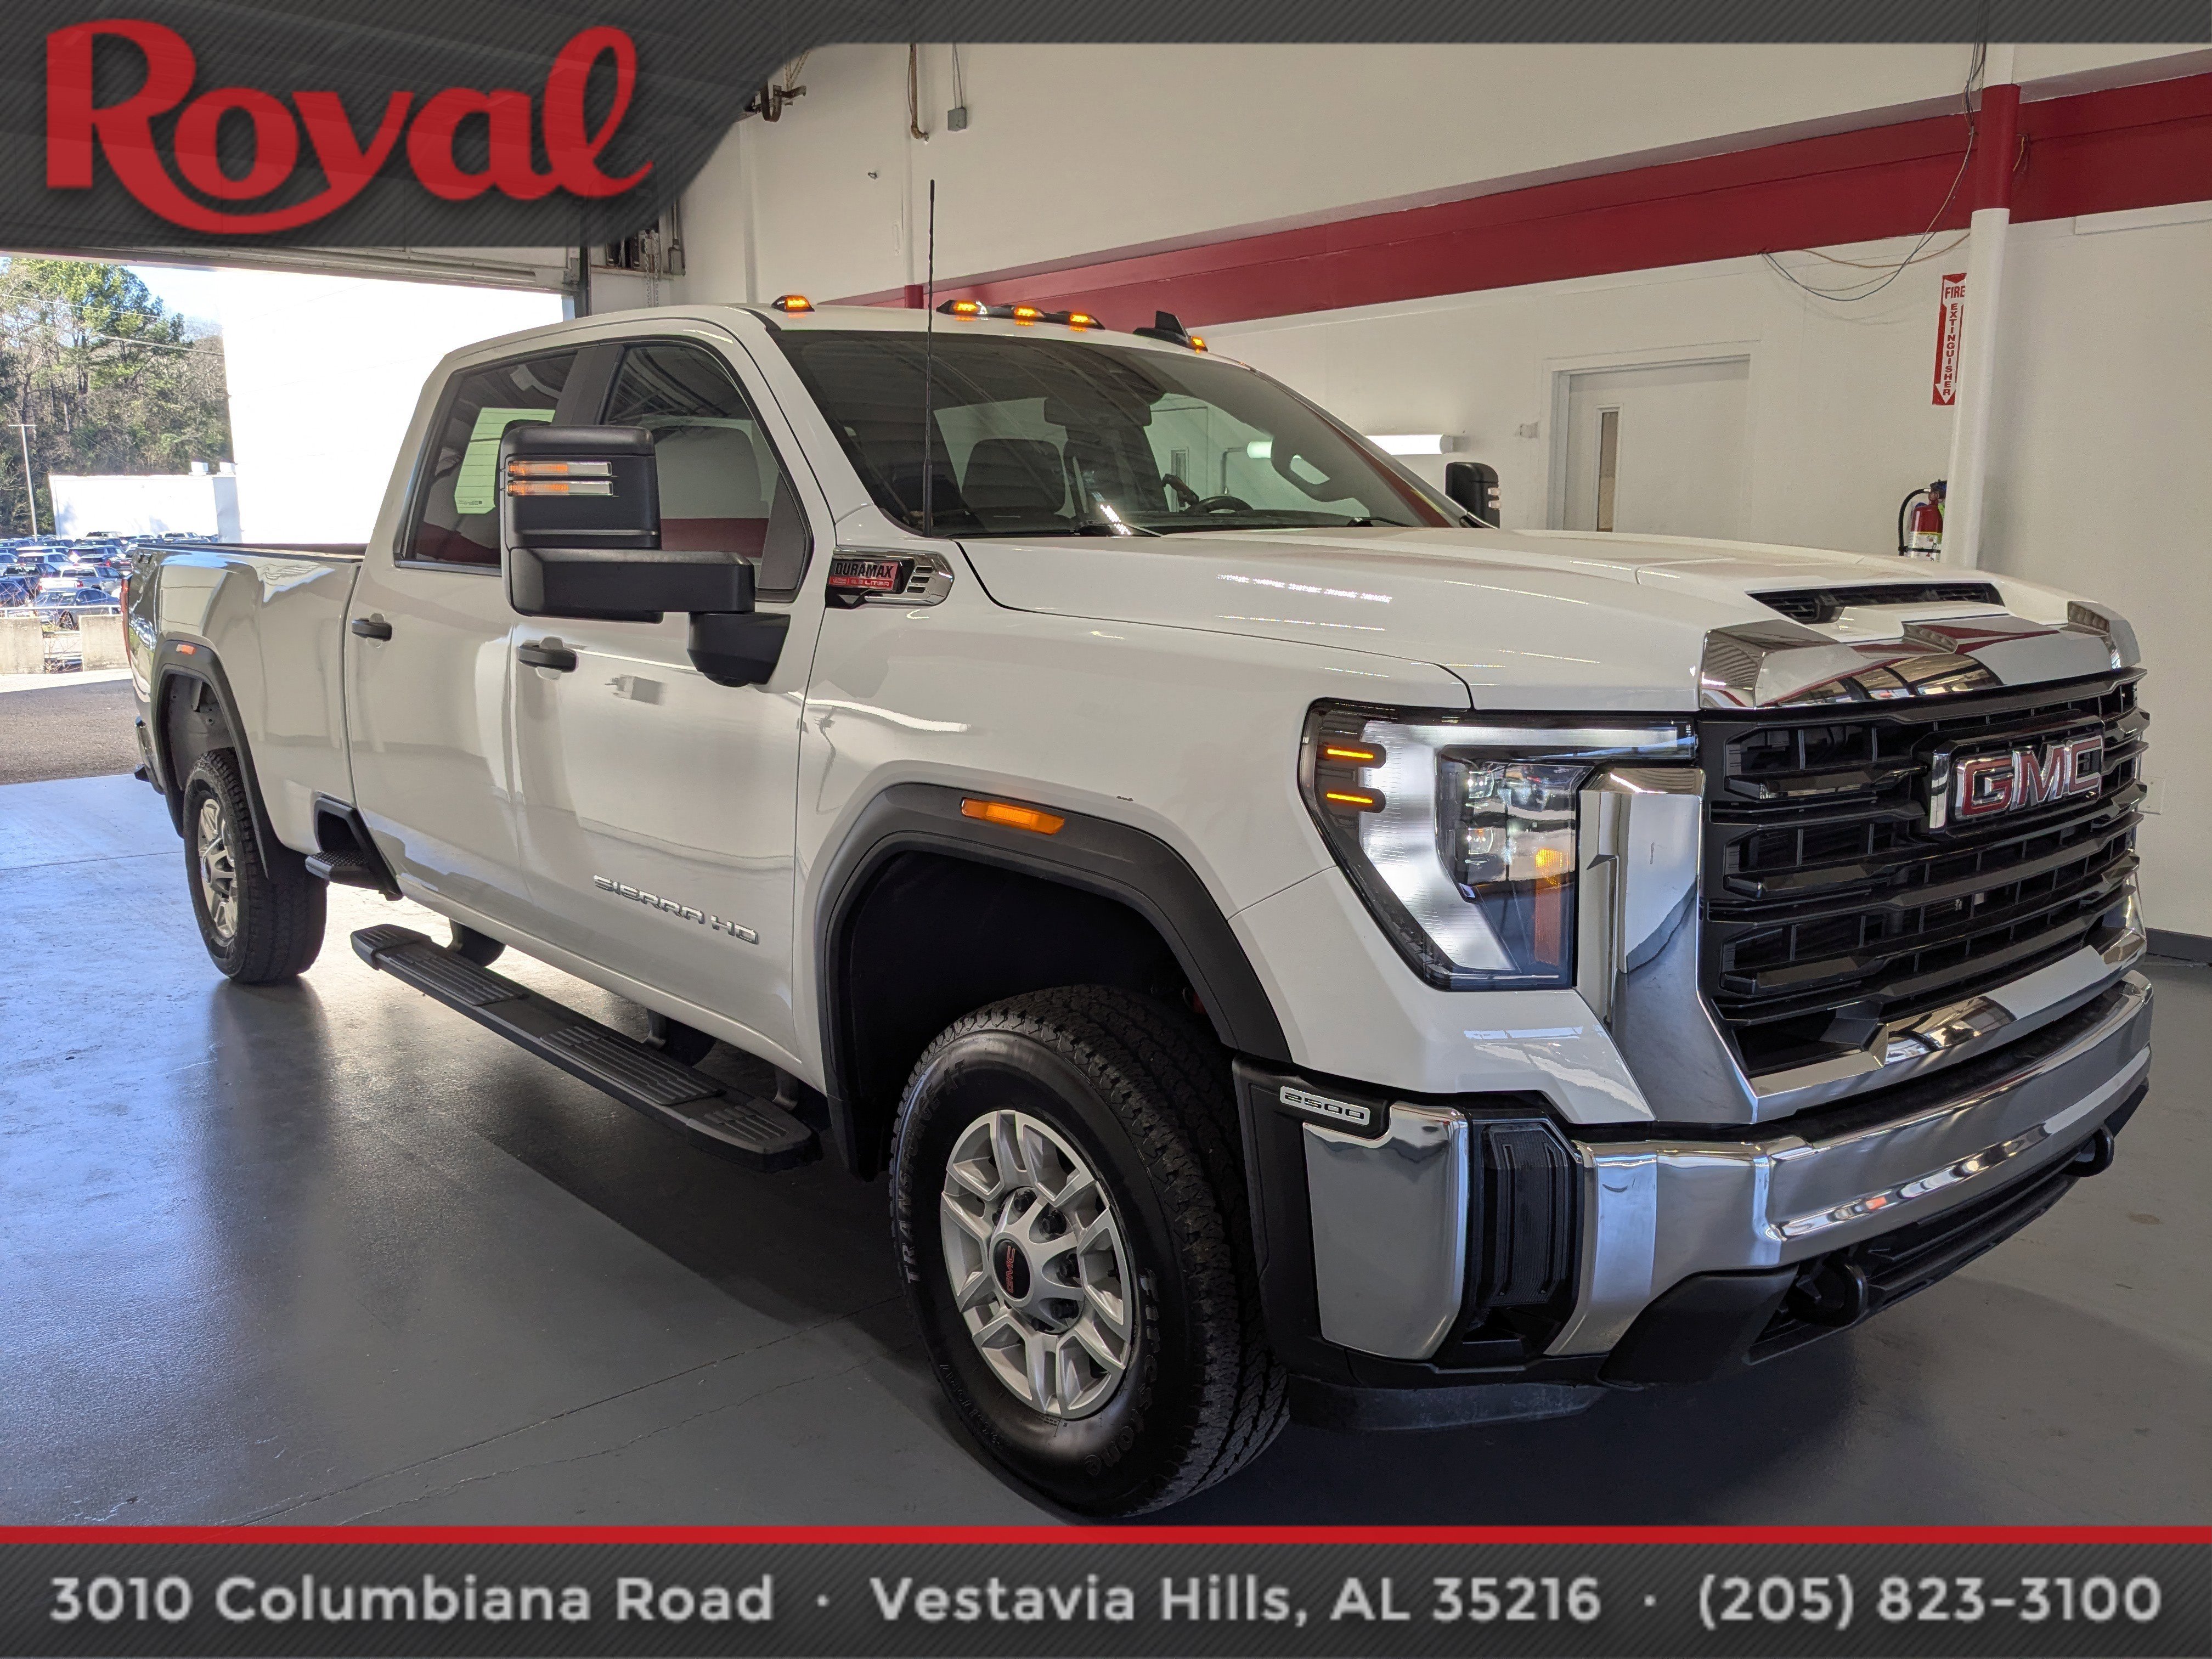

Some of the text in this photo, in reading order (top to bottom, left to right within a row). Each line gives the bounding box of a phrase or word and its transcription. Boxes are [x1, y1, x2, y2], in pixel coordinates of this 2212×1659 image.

[1945, 285, 1966, 299] FIRE
[1943, 303, 1959, 396] EXTINGUISHER
[834, 562, 894, 578] DURAMAX
[1955, 735, 2104, 820] GMC
[593, 874, 759, 945] SIERRA HD
[1284, 1092, 1364, 1120] 2500
[1006, 1245, 1016, 1294] GMC
